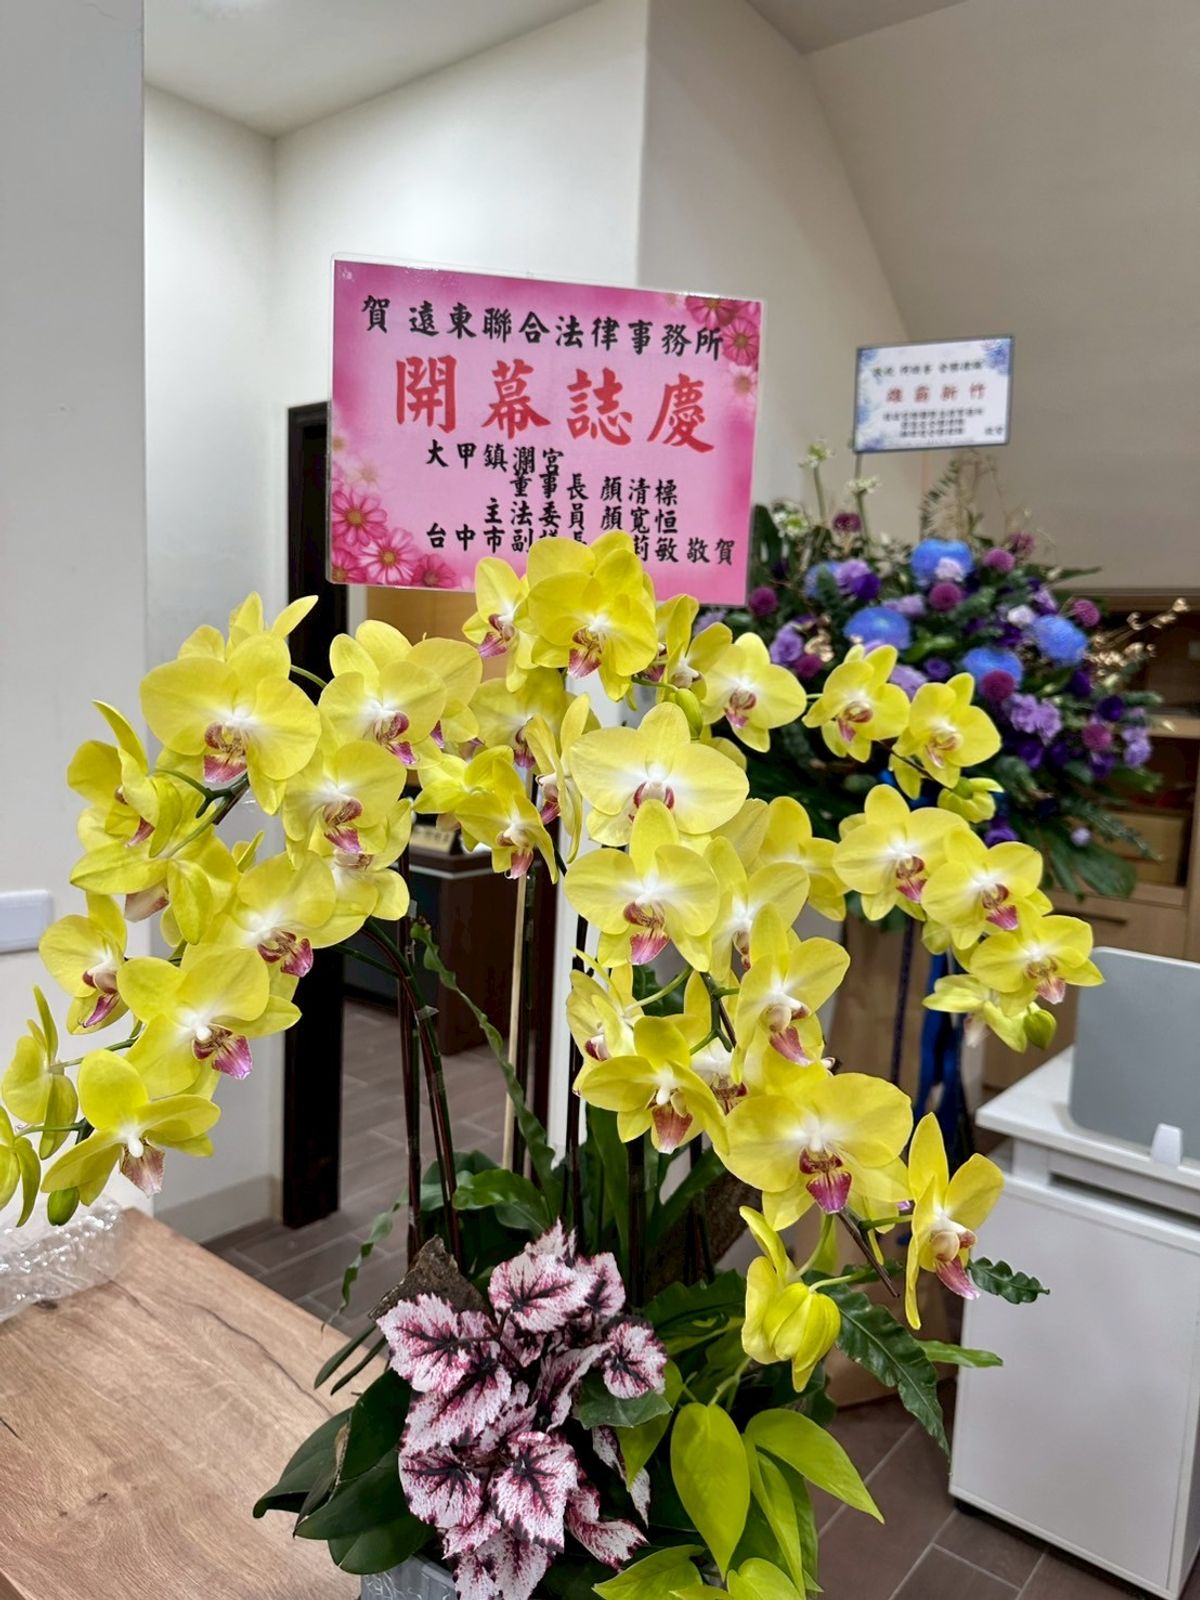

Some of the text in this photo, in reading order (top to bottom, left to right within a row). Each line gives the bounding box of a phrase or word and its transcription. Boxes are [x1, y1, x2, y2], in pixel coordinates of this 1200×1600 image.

[362, 294, 723, 360] 賀 遠東聯合法律事務所
[396, 354, 714, 452] 開幕誌慶
[426, 439, 564, 475] 大甲鎮瀾宮
[510, 471, 678, 506] 董事長 顏清標
